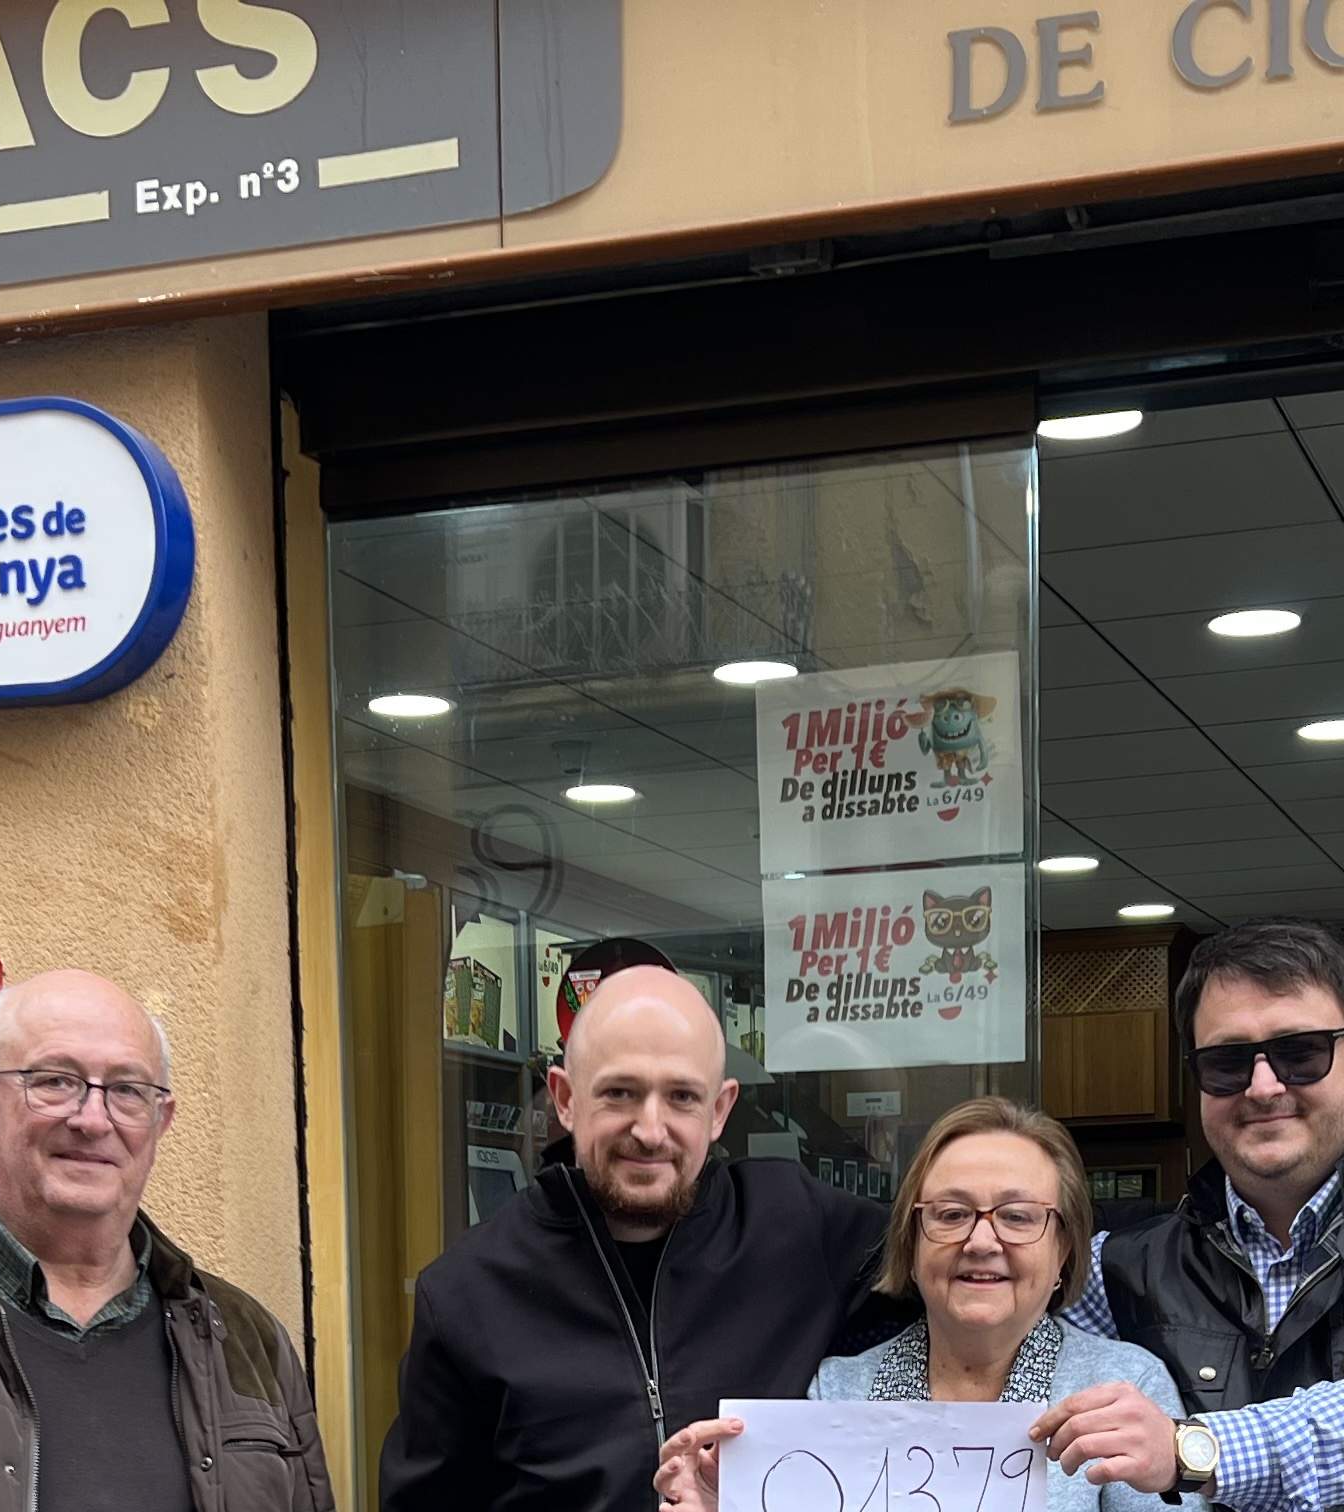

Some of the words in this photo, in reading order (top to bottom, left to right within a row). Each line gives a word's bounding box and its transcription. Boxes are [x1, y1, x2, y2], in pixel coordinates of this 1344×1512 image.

[947, 11, 1105, 125] DE
[136, 179, 219, 216] Exp.
[43, 502, 87, 538] de
[793, 747, 843, 776] Per
[780, 777, 815, 803] De
[821, 768, 917, 802] dilluns
[926, 796, 940, 807] La
[942, 787, 985, 806] 6/49
[802, 804, 816, 823] a
[821, 793, 920, 822] dissabte
[799, 951, 848, 977] Per
[785, 977, 820, 1003] De
[826, 972, 922, 1004] dilluns
[927, 992, 940, 1004] La
[943, 983, 989, 1003] 6/49
[806, 1005, 820, 1023] a
[825, 998, 924, 1023] dissabte
